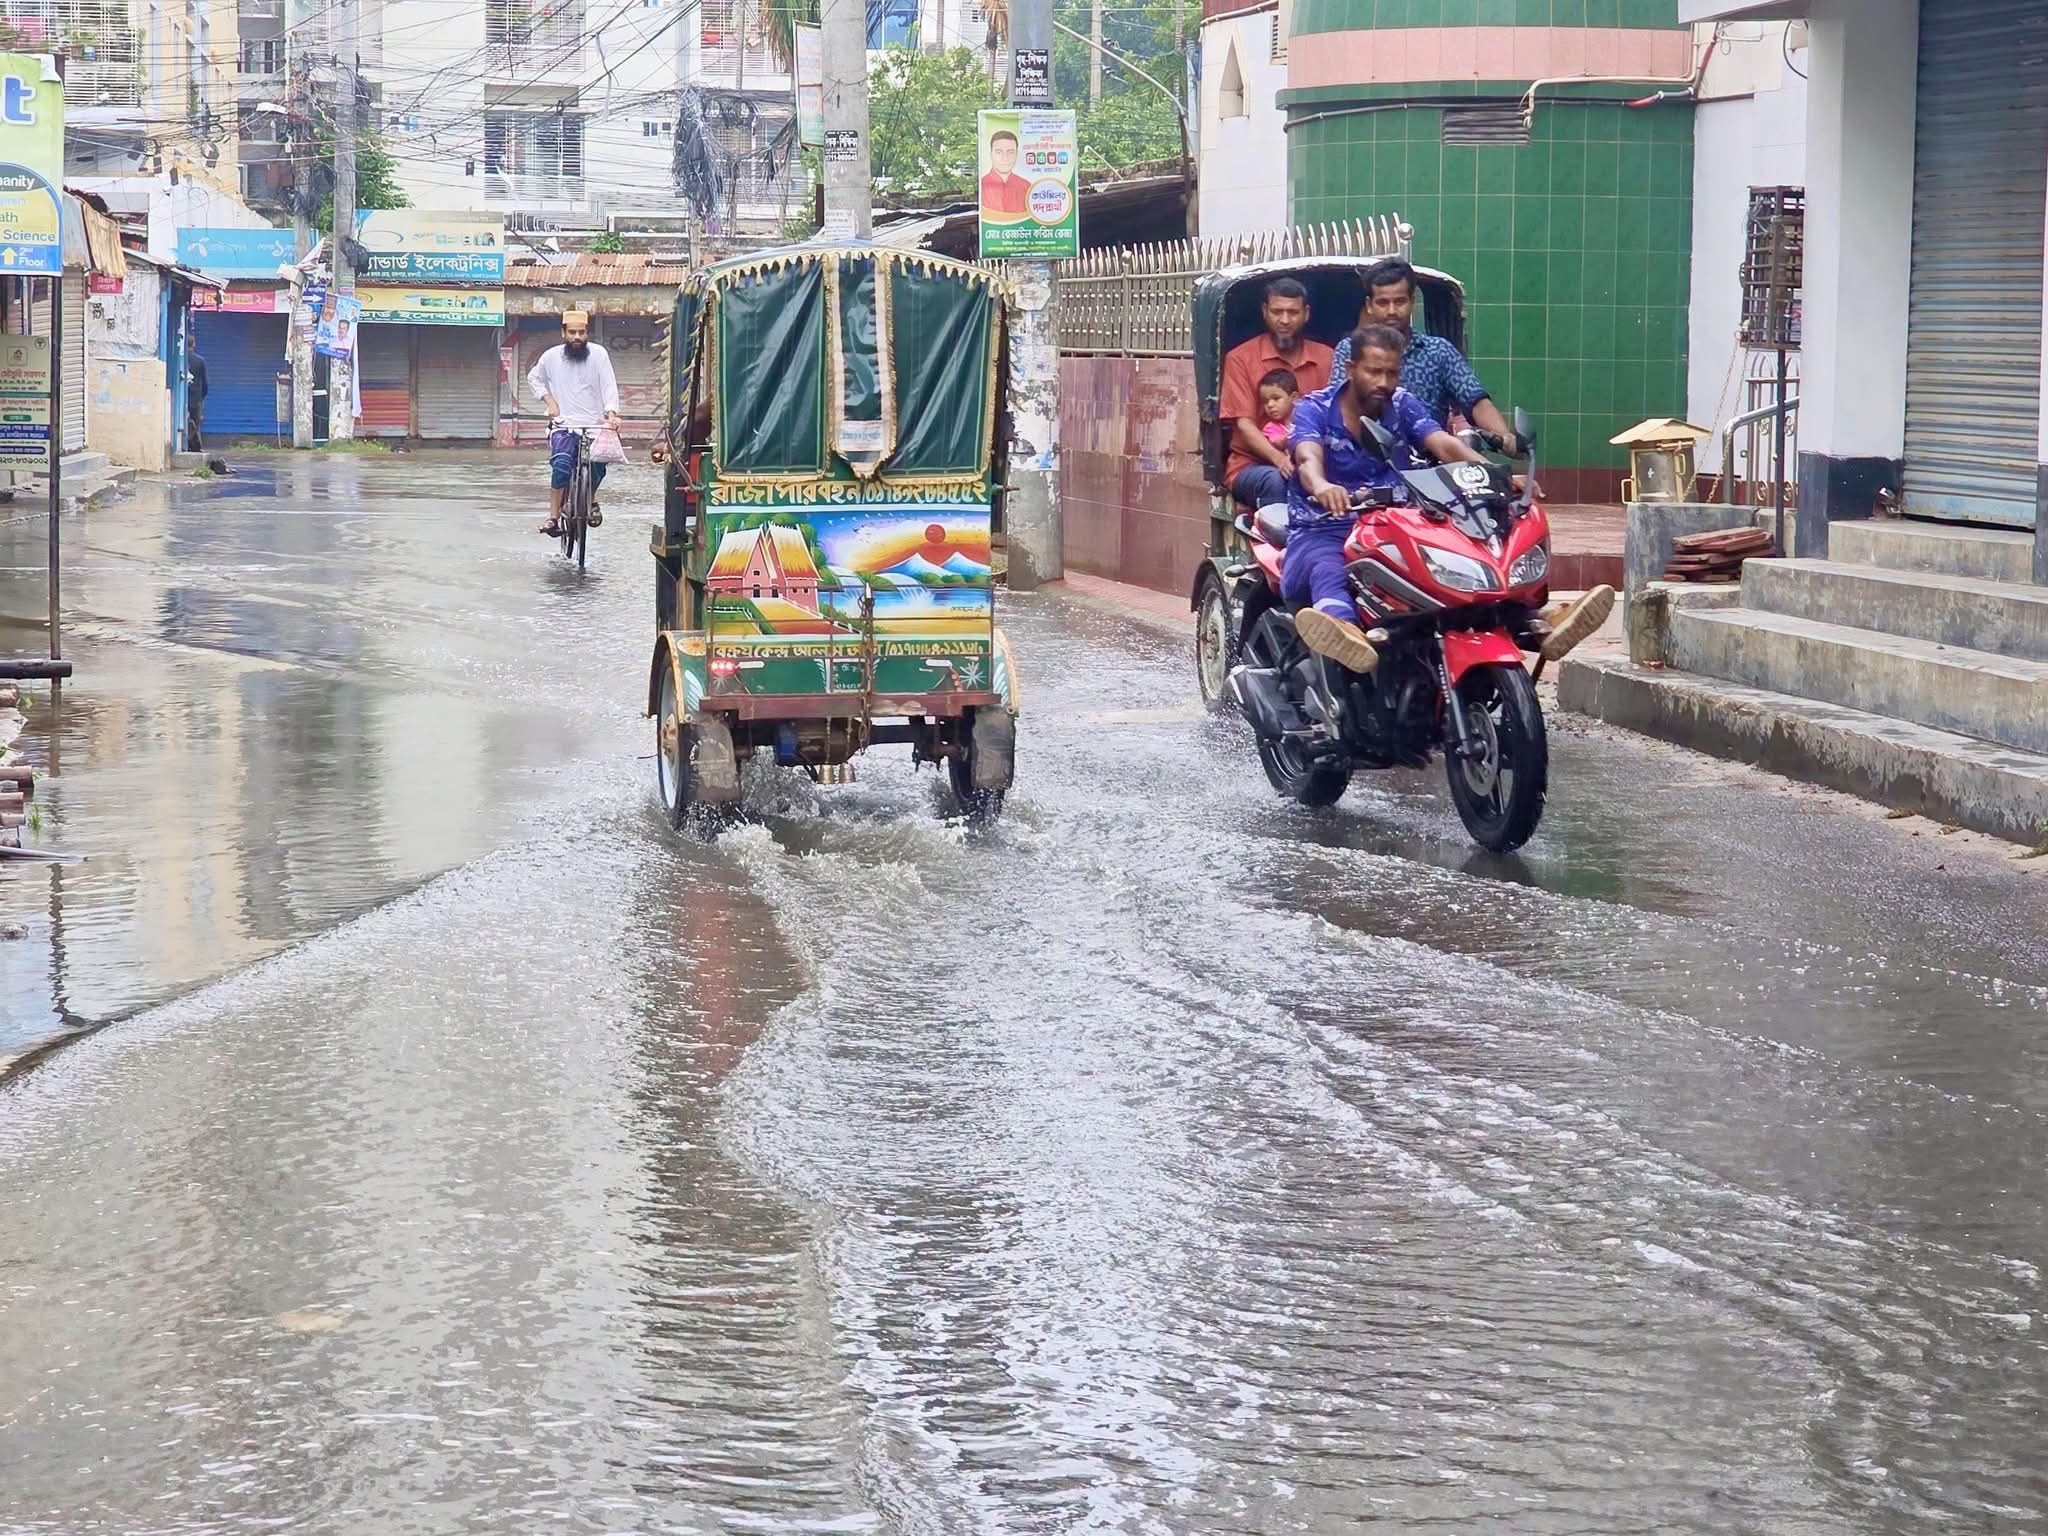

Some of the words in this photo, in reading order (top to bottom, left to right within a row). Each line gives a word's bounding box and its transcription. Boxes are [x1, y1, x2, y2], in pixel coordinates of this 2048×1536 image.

[3, 229, 56, 242] Science
[18, 256, 44, 267] Floor
[413, 252, 499, 273] ইলেকট্রনিক্স
[709, 481, 774, 505] রাজা
